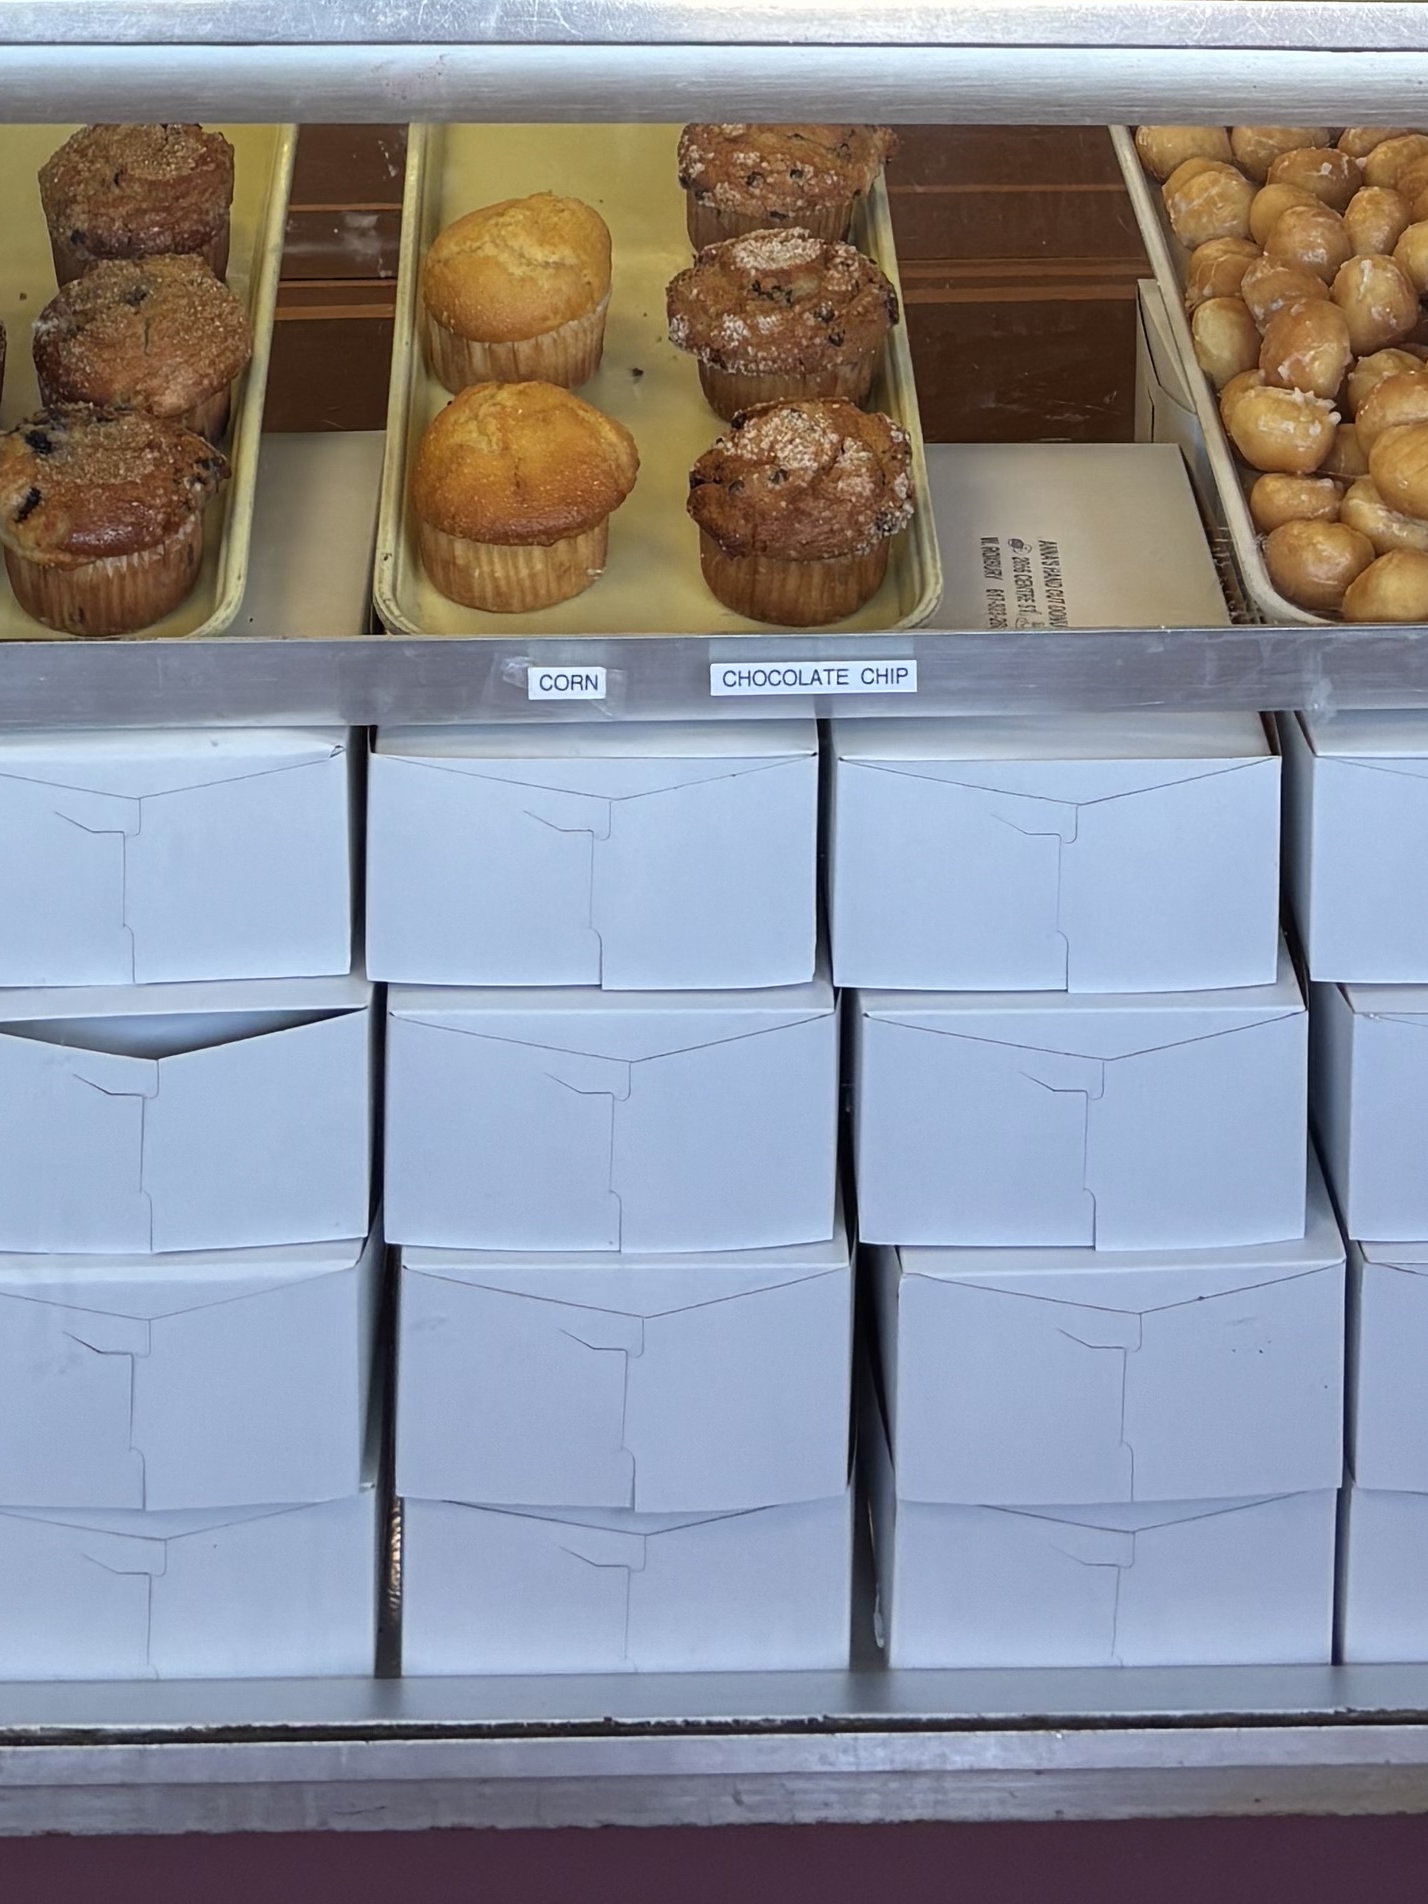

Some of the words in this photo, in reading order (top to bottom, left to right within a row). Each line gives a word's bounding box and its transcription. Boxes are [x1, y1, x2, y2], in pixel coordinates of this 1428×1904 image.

[539, 673, 599, 692] CORN
[721, 668, 849, 689] CHOCOLATE
[860, 666, 909, 686] CHIP
